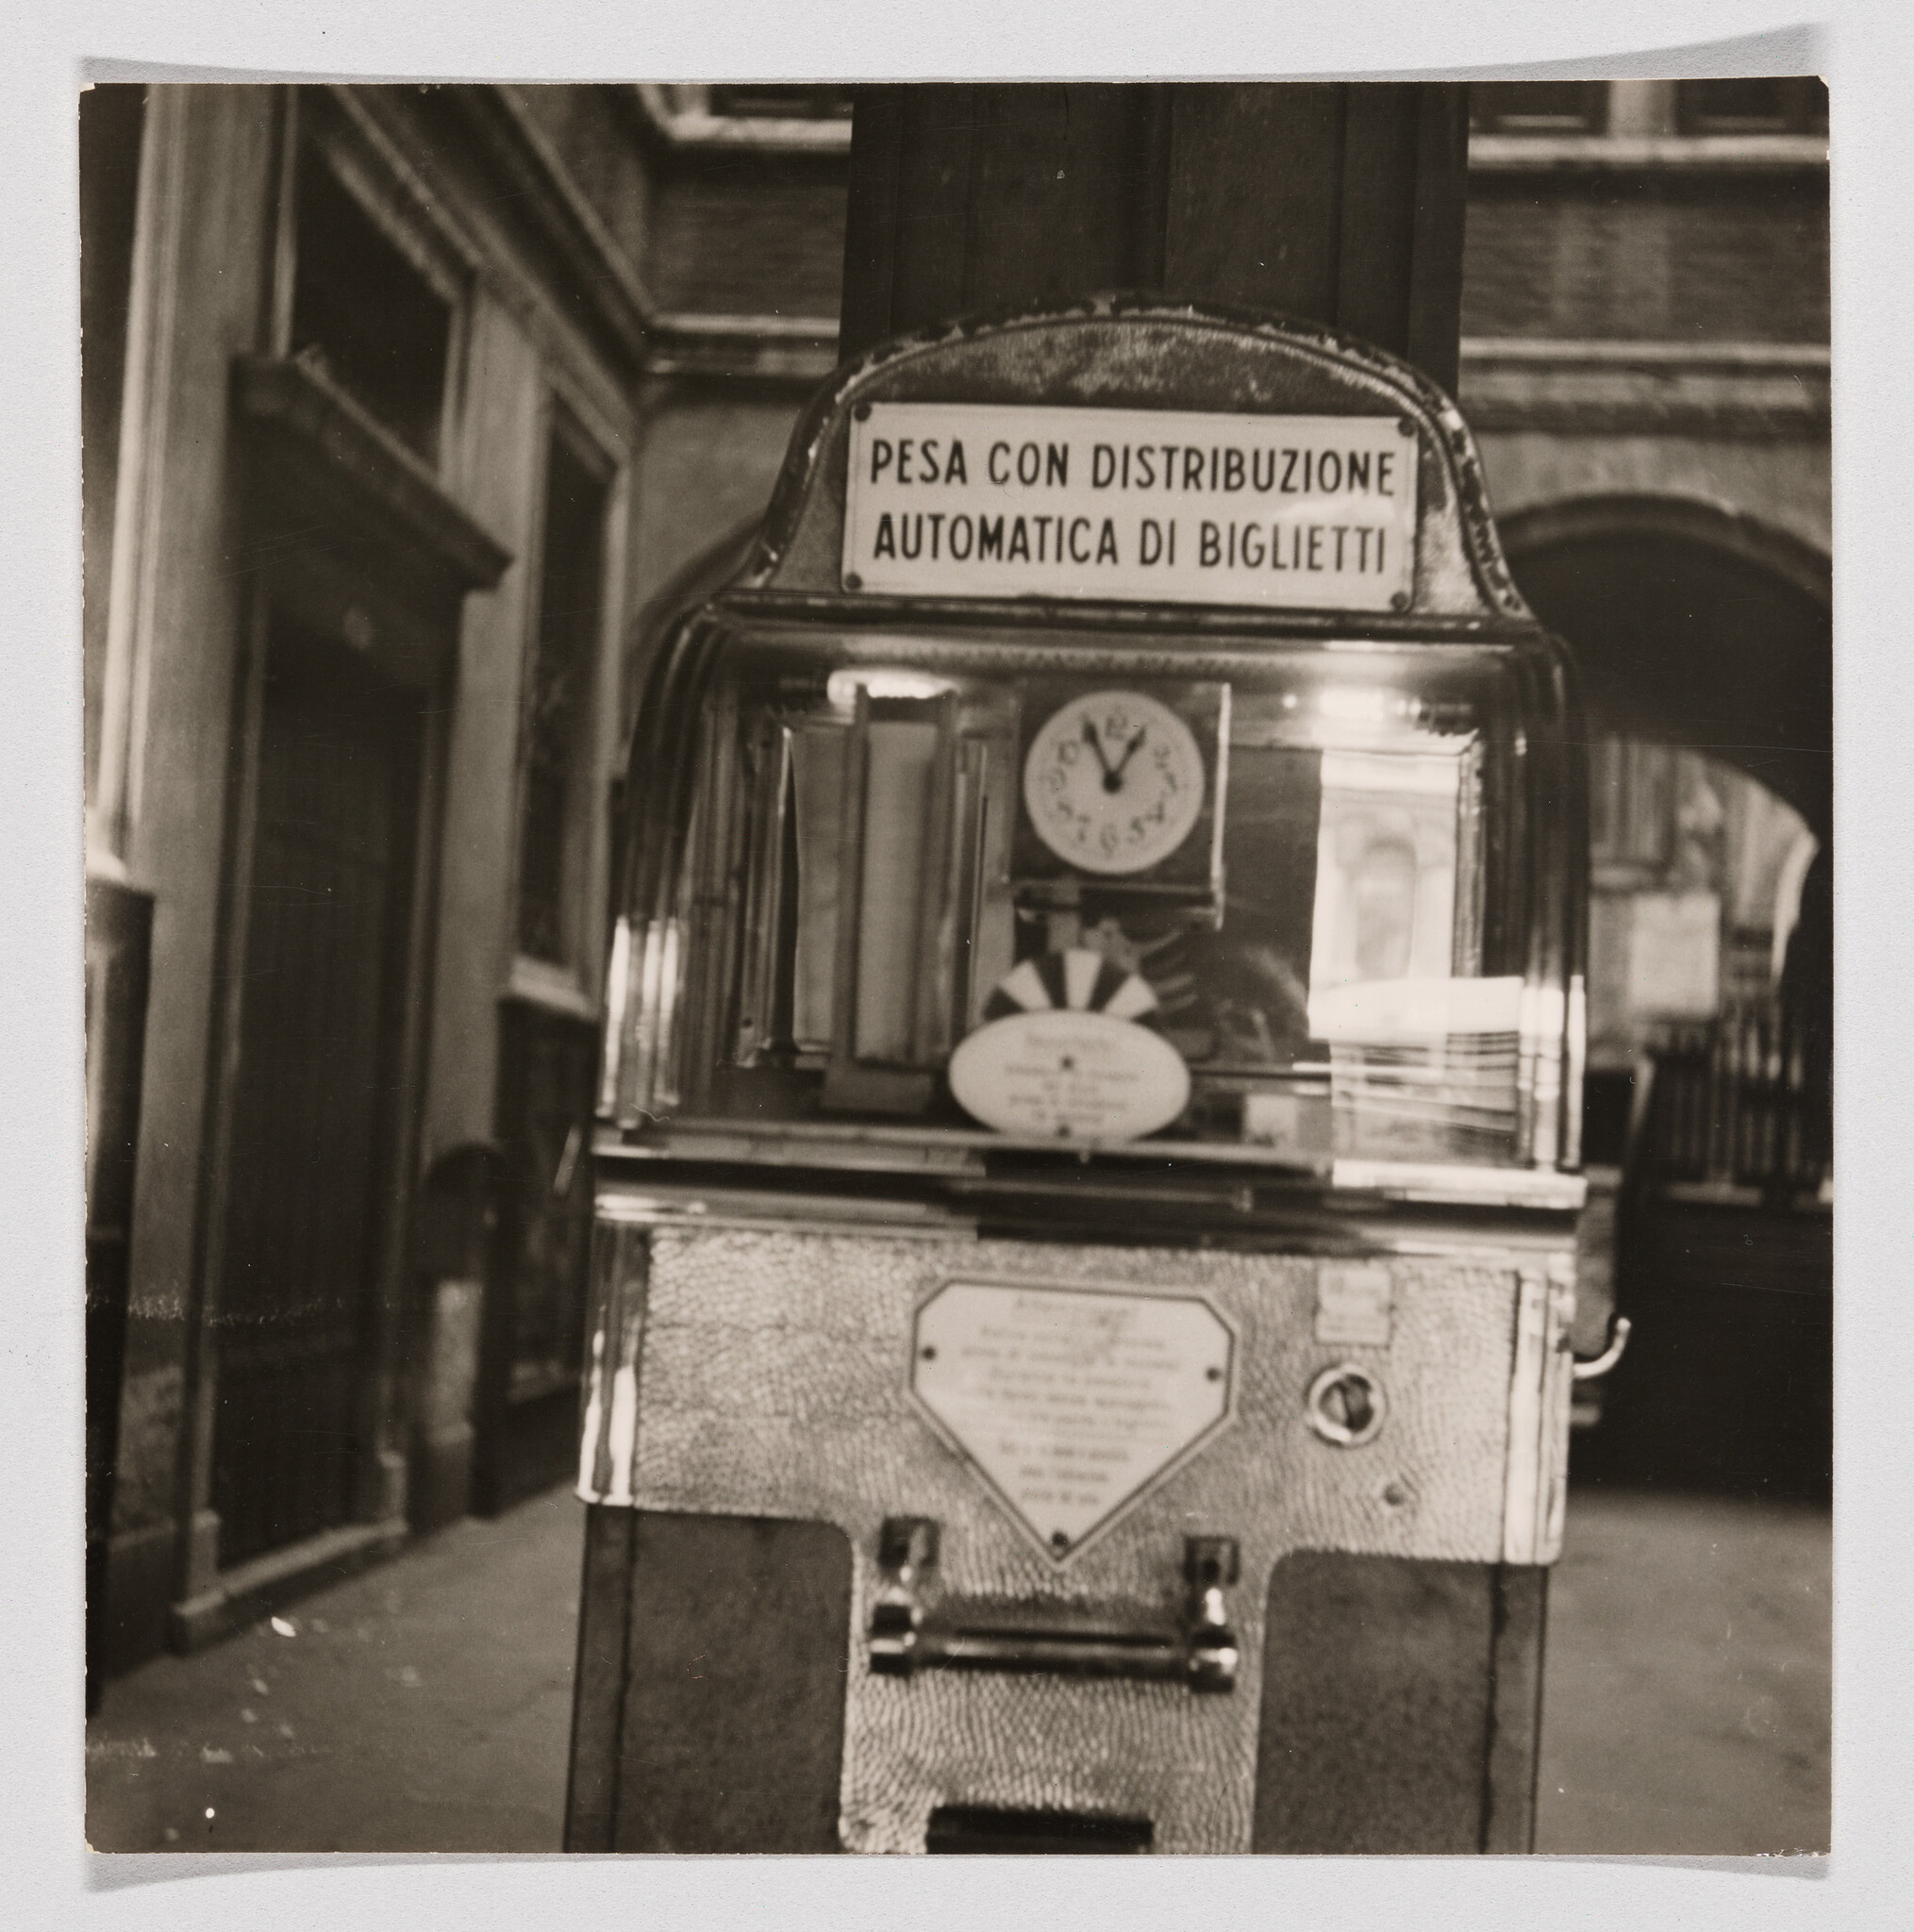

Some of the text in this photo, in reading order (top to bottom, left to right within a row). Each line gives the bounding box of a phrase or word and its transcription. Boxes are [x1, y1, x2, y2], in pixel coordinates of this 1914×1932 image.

[871, 438, 1396, 497] PESA CON DISTRIBUZIONE
[874, 512, 1386, 575] AUTOMATICA DI BIGLIETTI
[1105, 713, 1129, 742] 12
[1098, 821, 1121, 858] 6
[1123, 814, 1148, 846] 5
